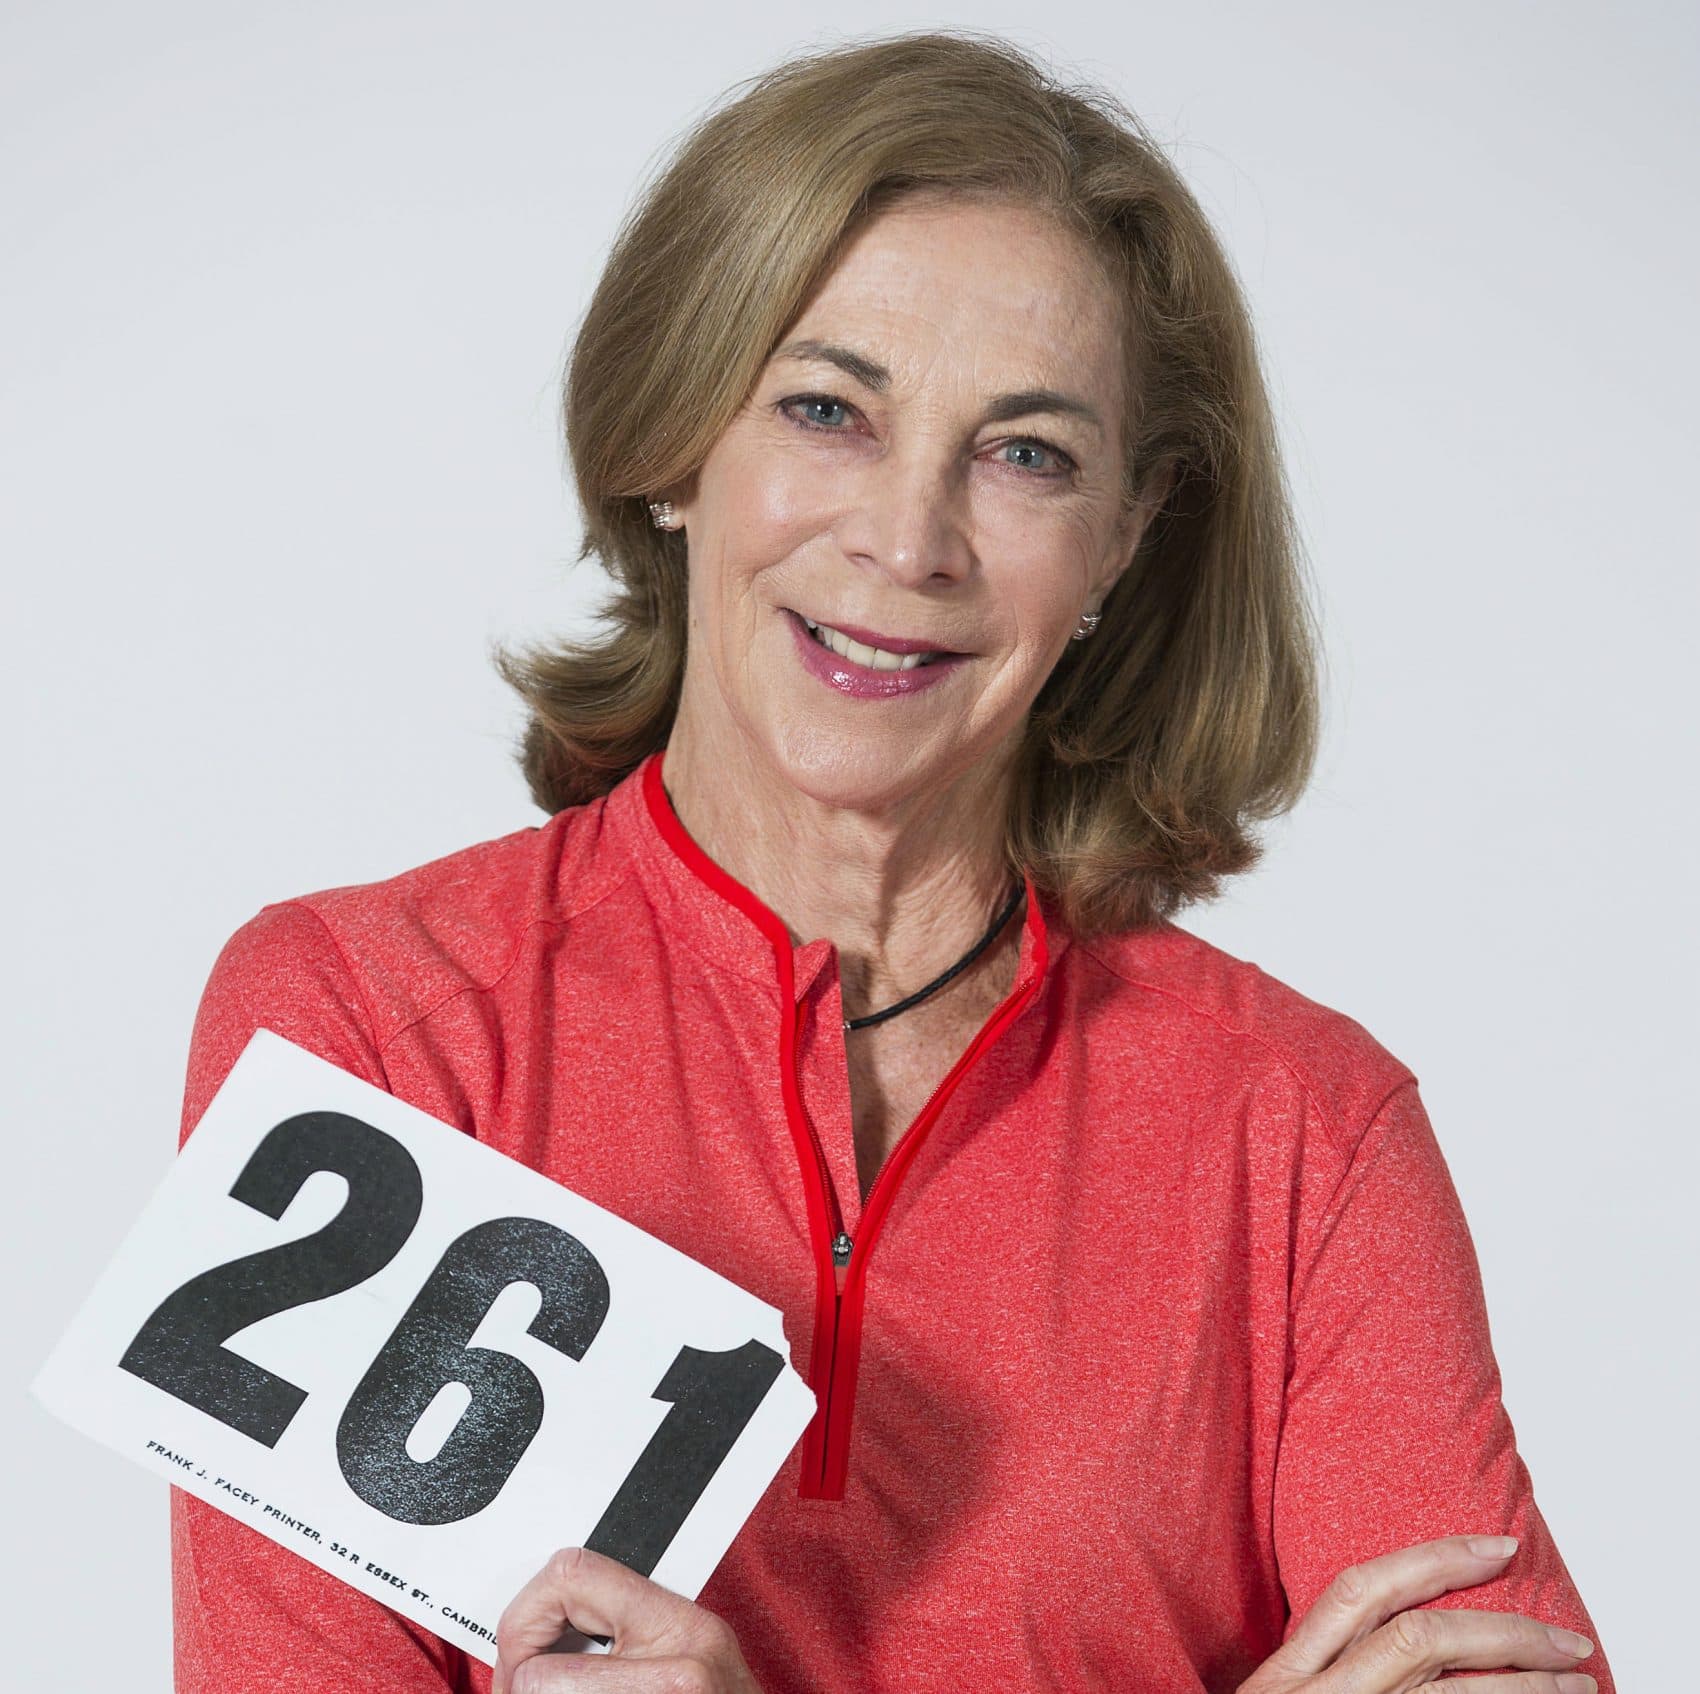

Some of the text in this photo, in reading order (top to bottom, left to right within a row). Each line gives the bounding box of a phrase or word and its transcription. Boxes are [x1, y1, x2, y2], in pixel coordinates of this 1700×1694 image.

[118, 1109, 786, 1647] 261
[146, 1440, 194, 1470] FRANK
[196, 1469, 208, 1479] J.
[214, 1477, 260, 1505] FACEY
[263, 1504, 322, 1544] PRINTER,
[329, 1542, 348, 1557] 32
[350, 1553, 361, 1565] R
[365, 1562, 408, 1591] ESSEX
